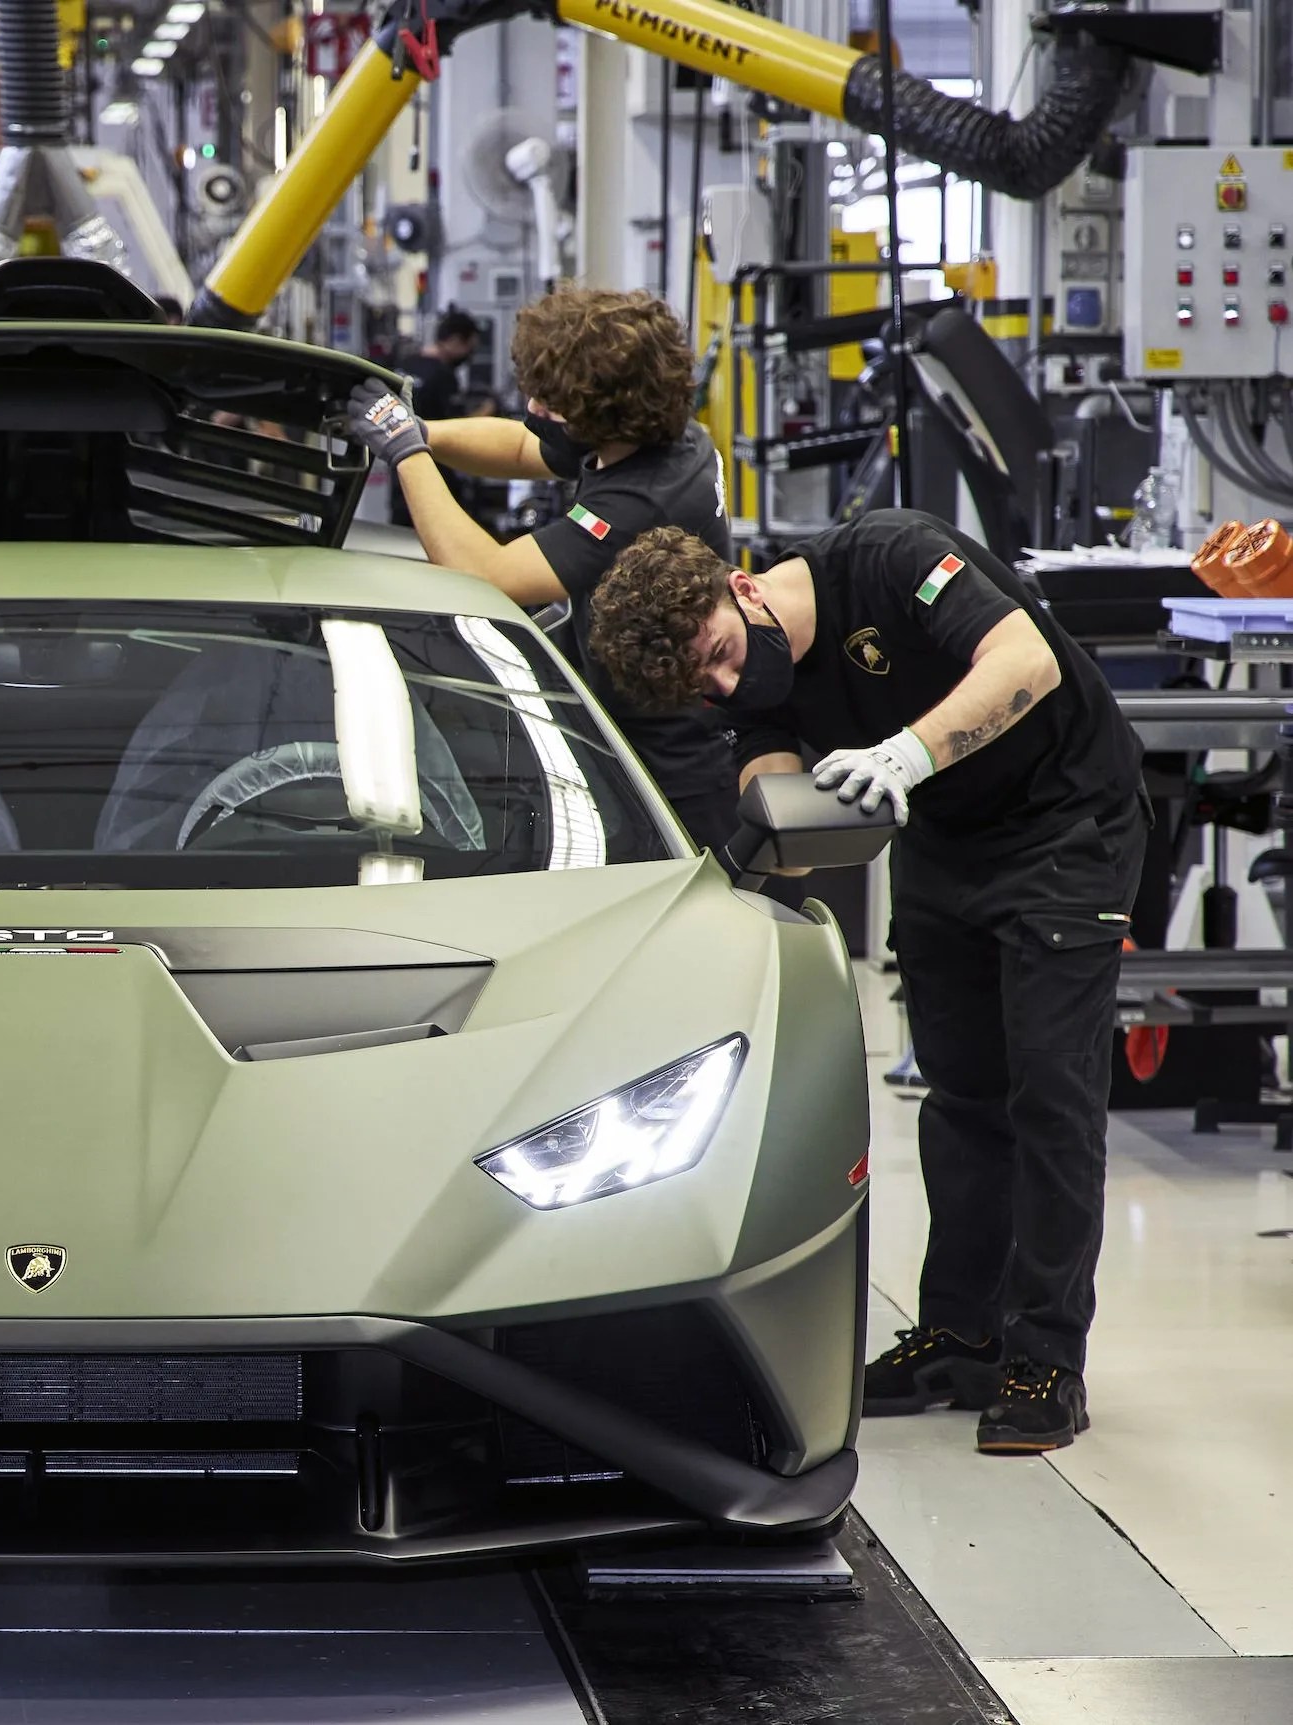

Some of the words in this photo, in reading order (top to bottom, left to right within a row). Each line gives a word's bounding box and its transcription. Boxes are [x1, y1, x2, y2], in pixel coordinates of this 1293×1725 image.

[594, 0, 750, 65] PLYMOVENT
[364, 393, 395, 421] uvex
[11, 1247, 62, 1257] LAMBORGHINI
